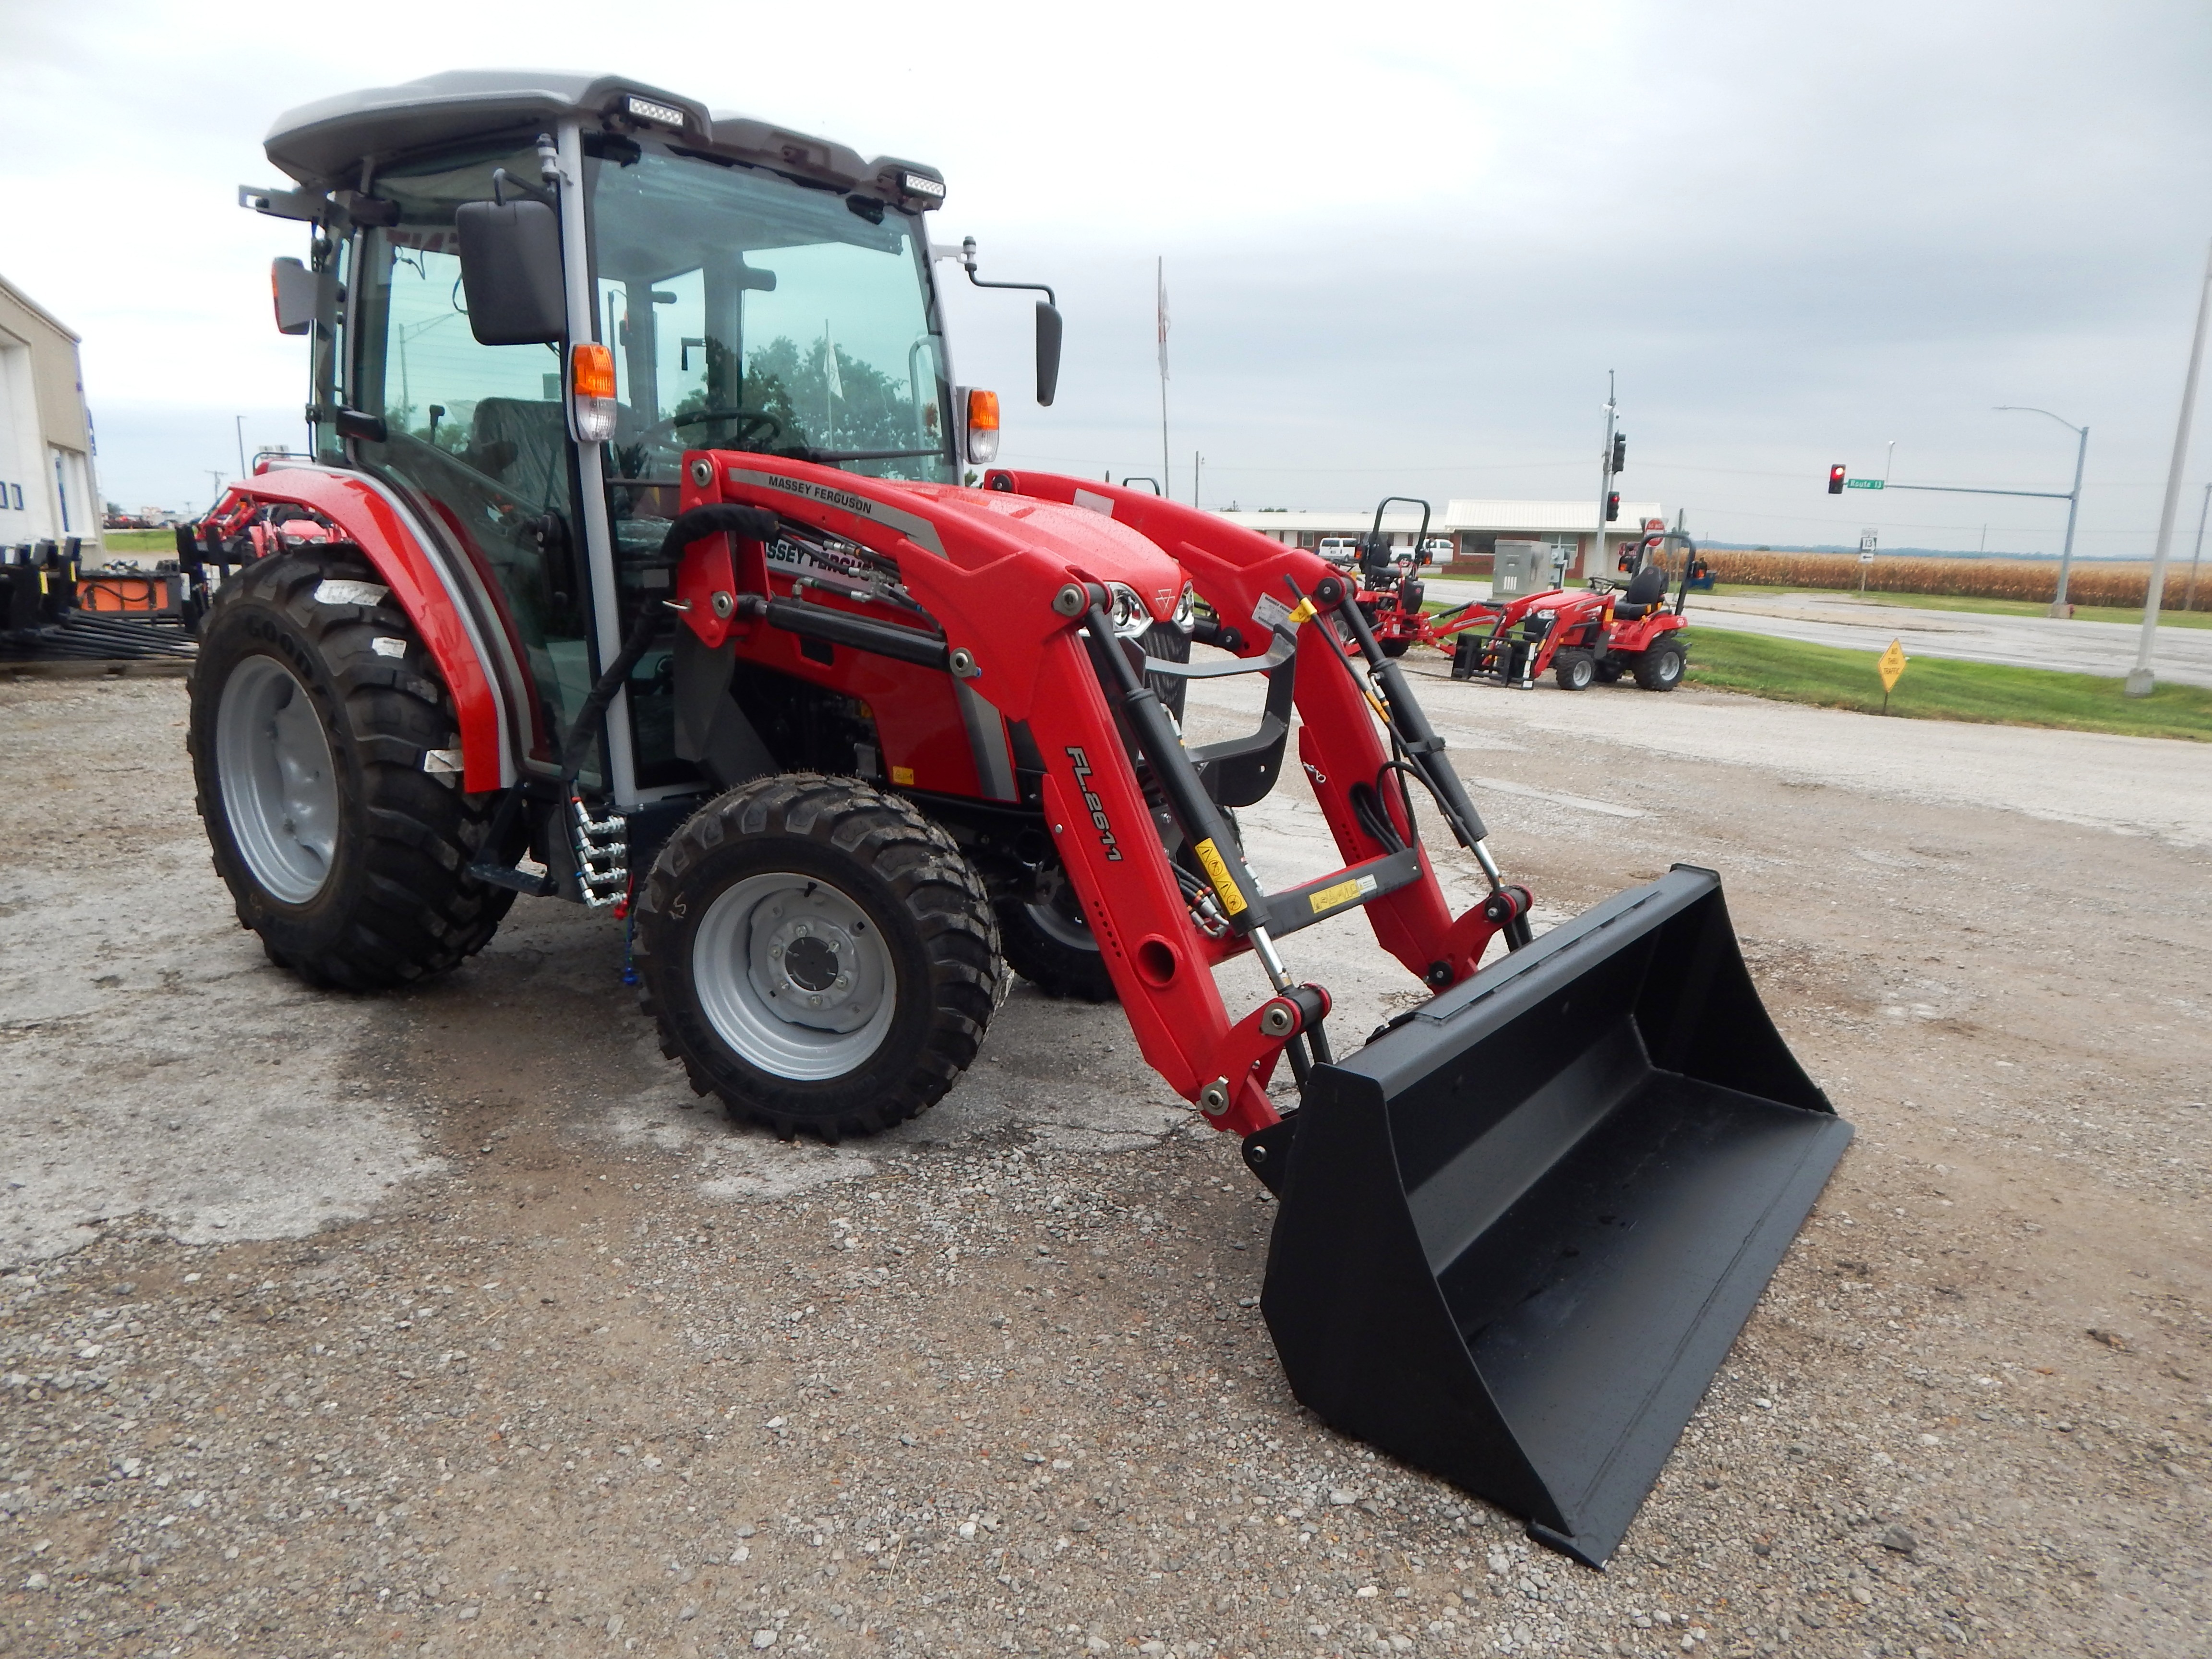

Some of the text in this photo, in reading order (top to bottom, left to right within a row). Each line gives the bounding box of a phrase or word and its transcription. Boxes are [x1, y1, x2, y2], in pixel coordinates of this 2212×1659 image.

[769, 476, 872, 514] MASSEY FERGUSON
[766, 542, 804, 565] SSEY
[1865, 539, 1873, 548] 13
[1065, 746, 1124, 861] FL.2611
